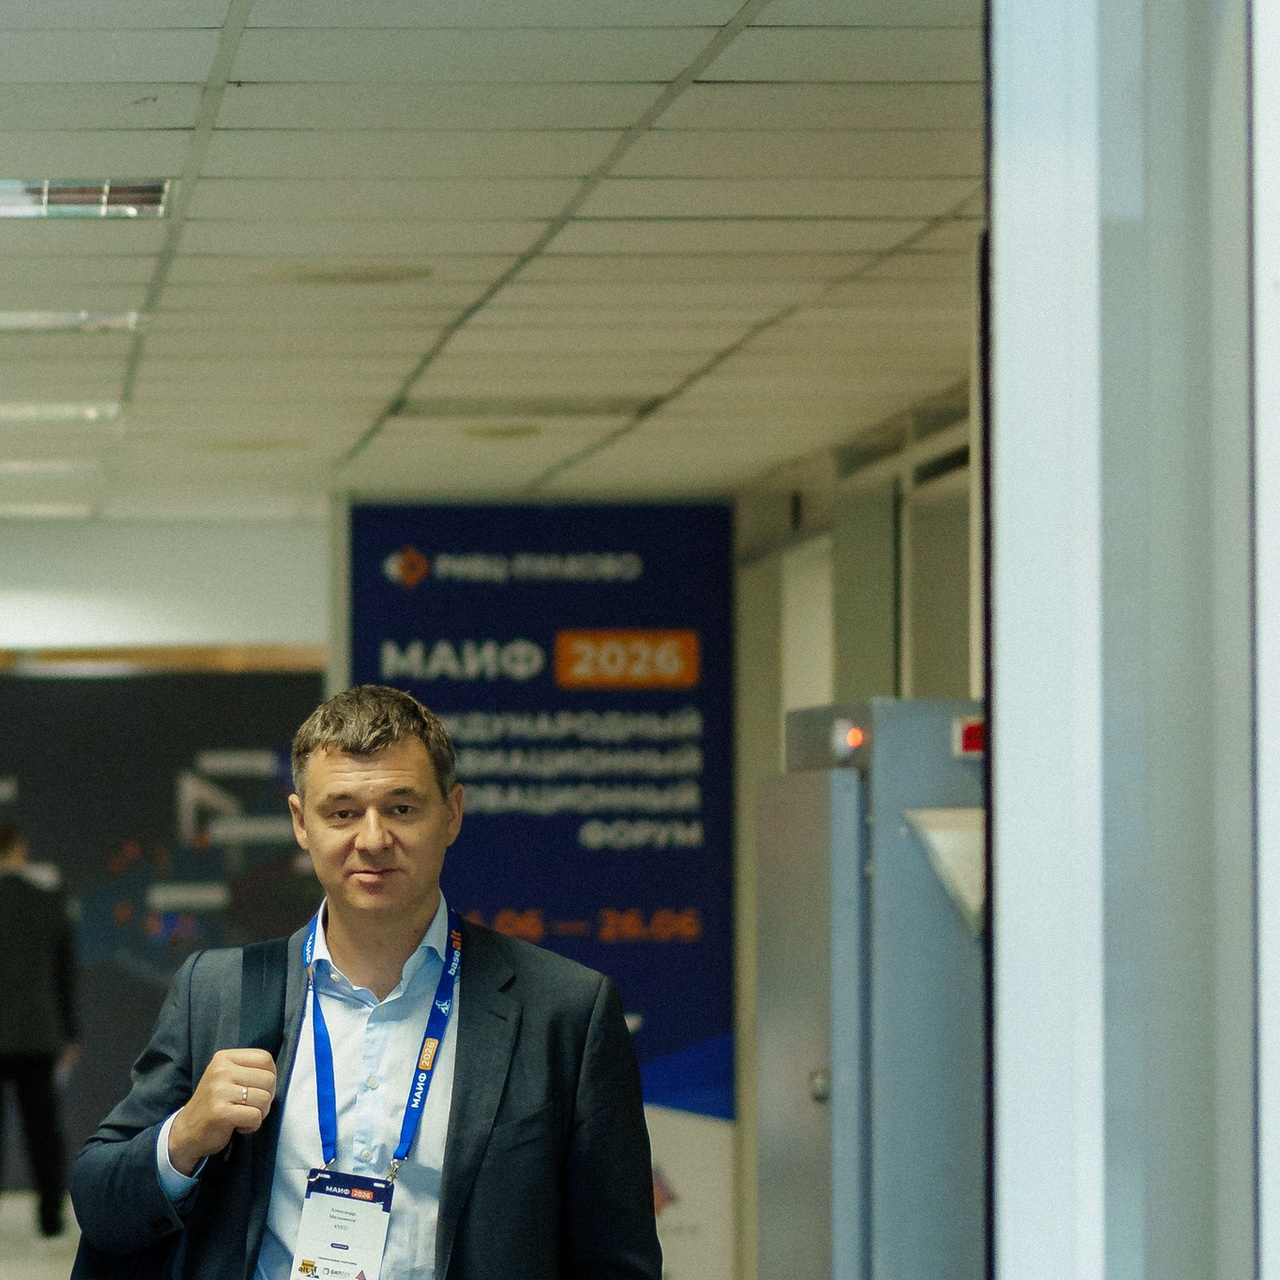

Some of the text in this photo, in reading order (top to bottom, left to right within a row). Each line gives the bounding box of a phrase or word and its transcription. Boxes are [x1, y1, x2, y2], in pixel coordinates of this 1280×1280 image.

[380, 639, 685, 681] МАИФ 2026
[411, 1040, 435, 1108] МАИФ 2026
[325, 1185, 371, 1199] МАИФ 2026
